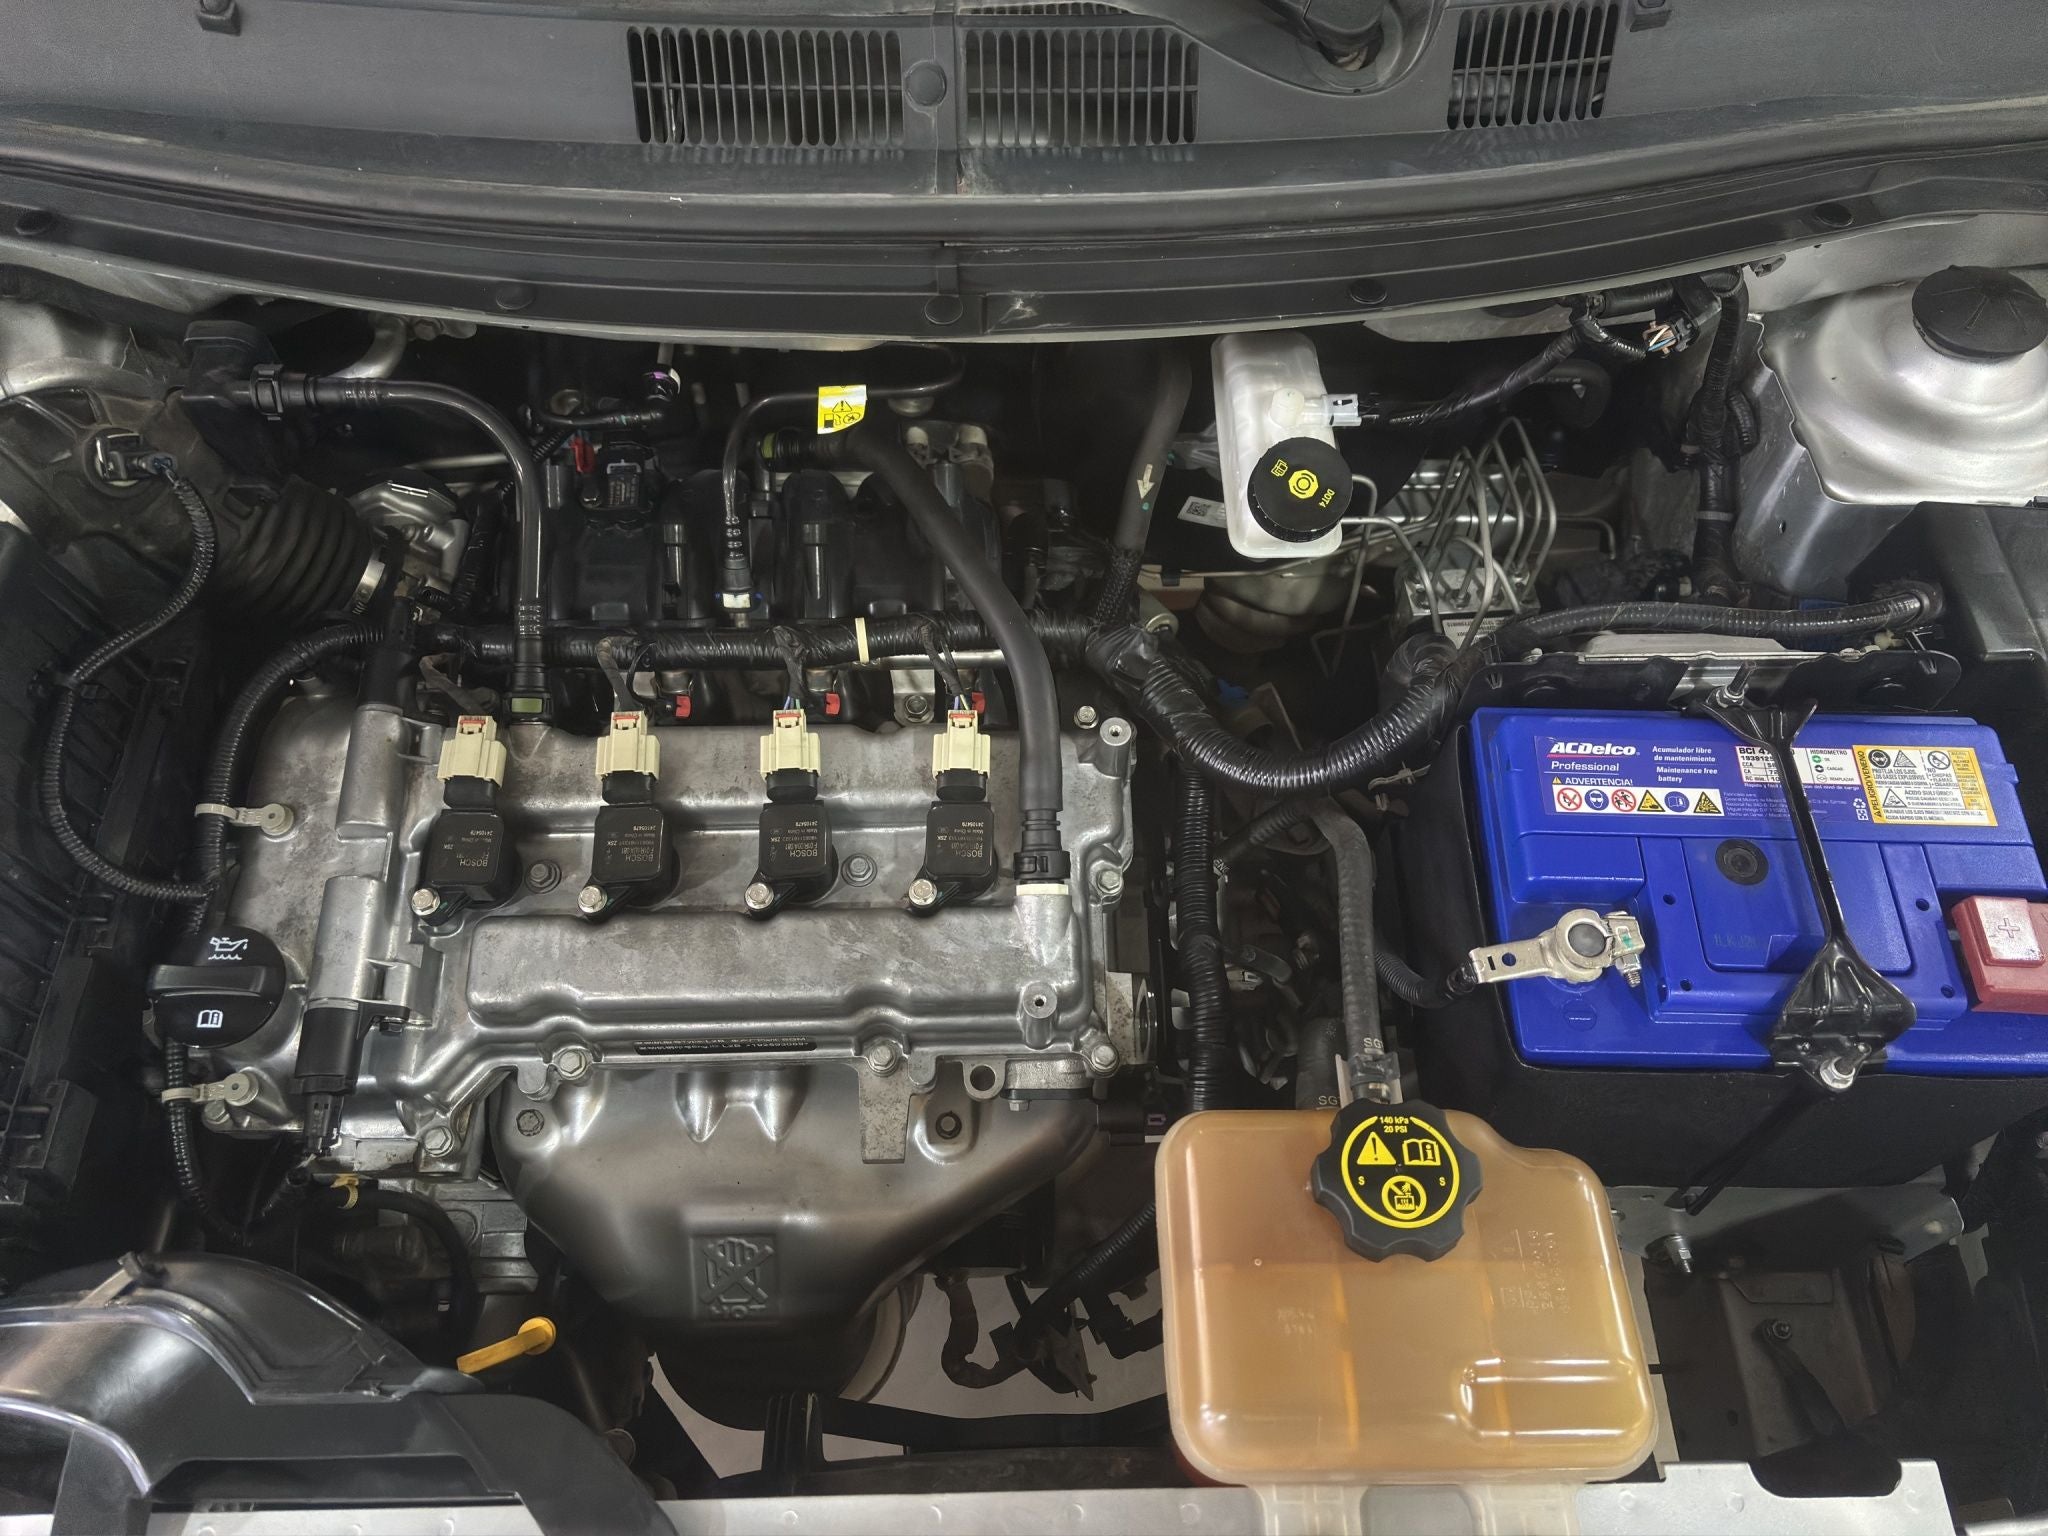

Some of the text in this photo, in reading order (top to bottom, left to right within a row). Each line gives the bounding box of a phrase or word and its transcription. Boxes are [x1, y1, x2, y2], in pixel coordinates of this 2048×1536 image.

[1318, 488, 1335, 508] DOT4
[1550, 742, 1637, 756] ACDelco
[1551, 760, 1620, 772] Professional
[1565, 777, 1633, 786] ADVERTENCIA!
[460, 859, 488, 867] BOSCH
[1363, 1038, 1384, 1048] SG
[1318, 1096, 1340, 1105] SG
